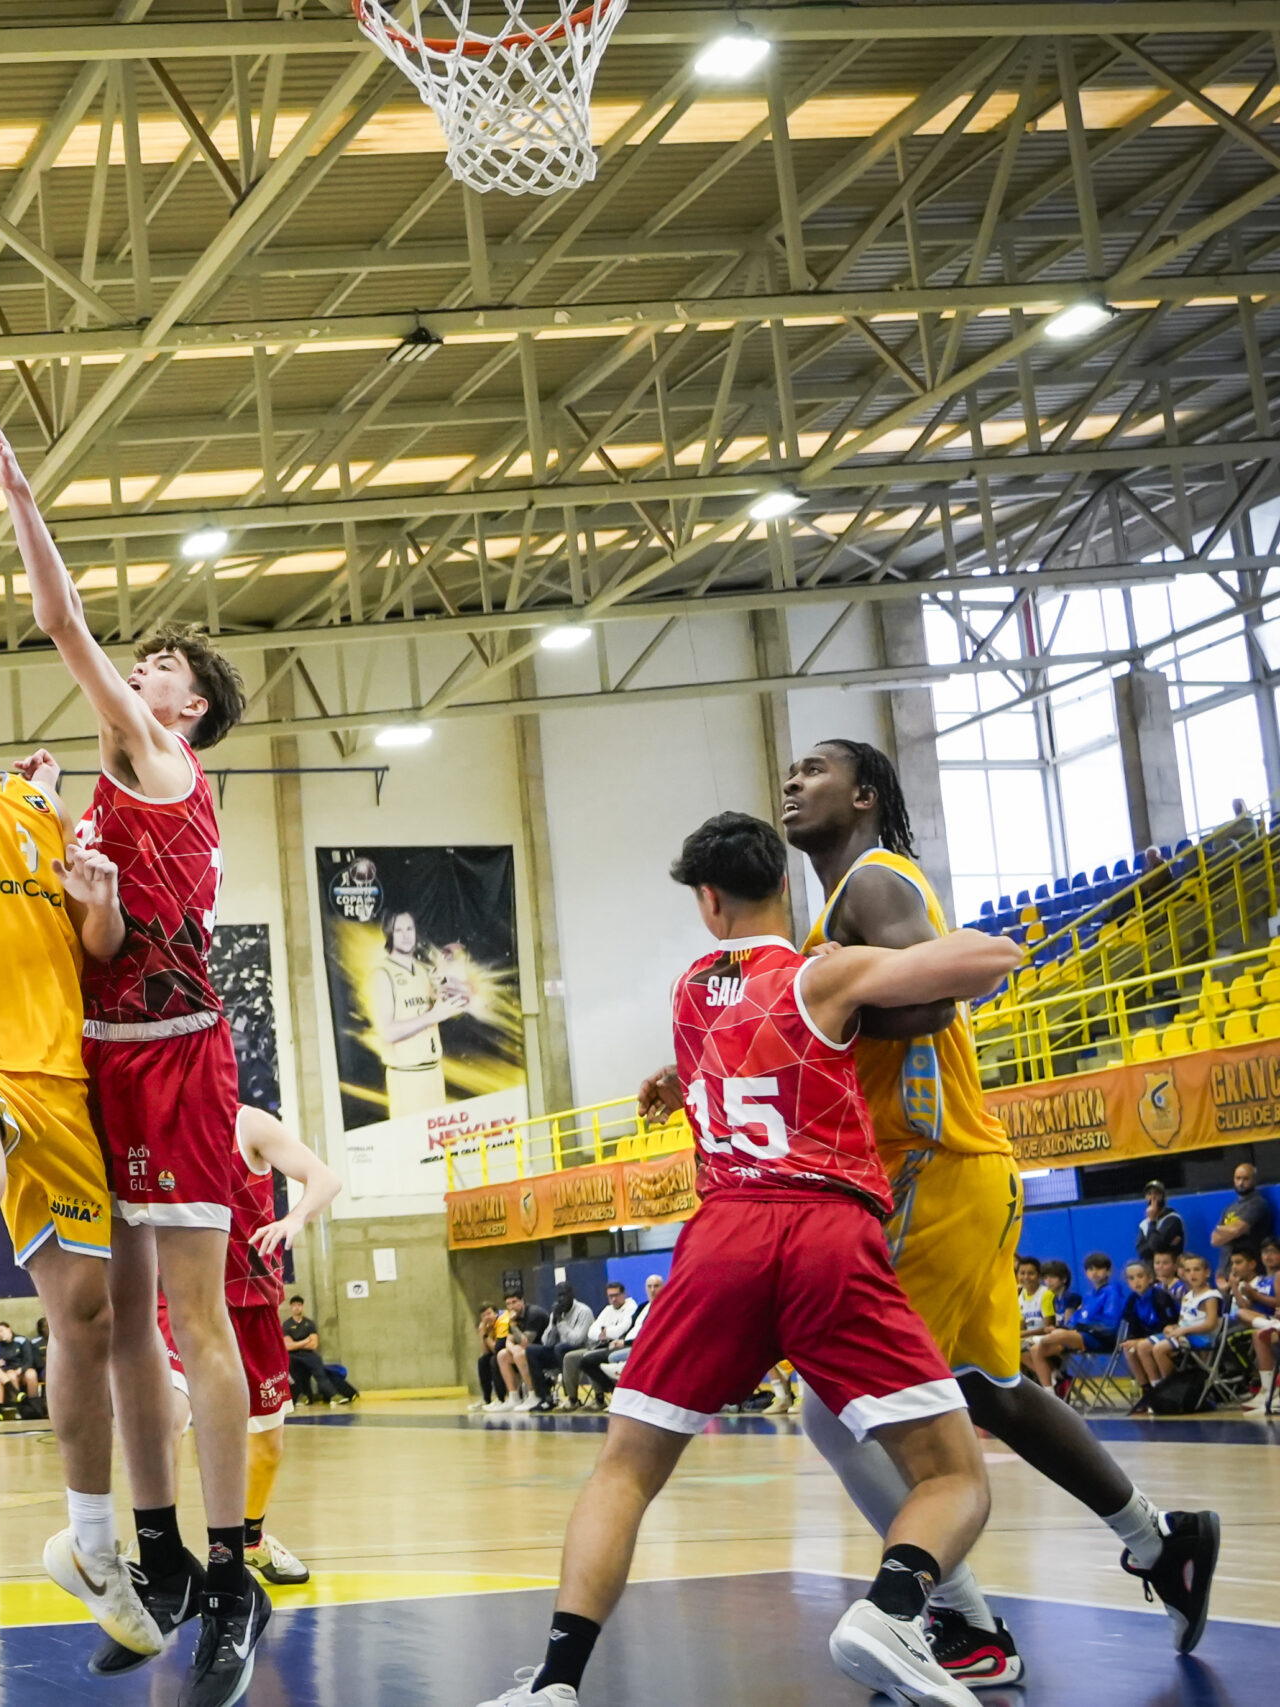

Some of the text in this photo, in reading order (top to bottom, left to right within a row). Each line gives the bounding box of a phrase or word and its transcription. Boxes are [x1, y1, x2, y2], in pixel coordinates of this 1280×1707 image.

[336, 896, 363, 906] COPA
[1211, 1059, 1267, 1106] GRAN
[428, 1111, 469, 1130] BRAD
[686, 1077, 791, 1160] 15
[1033, 1087, 1106, 1135] CANARIA
[1216, 1108, 1252, 1131] CLUB
[1254, 1105, 1273, 1126] DE
[429, 1116, 516, 1150] NEWLEY
